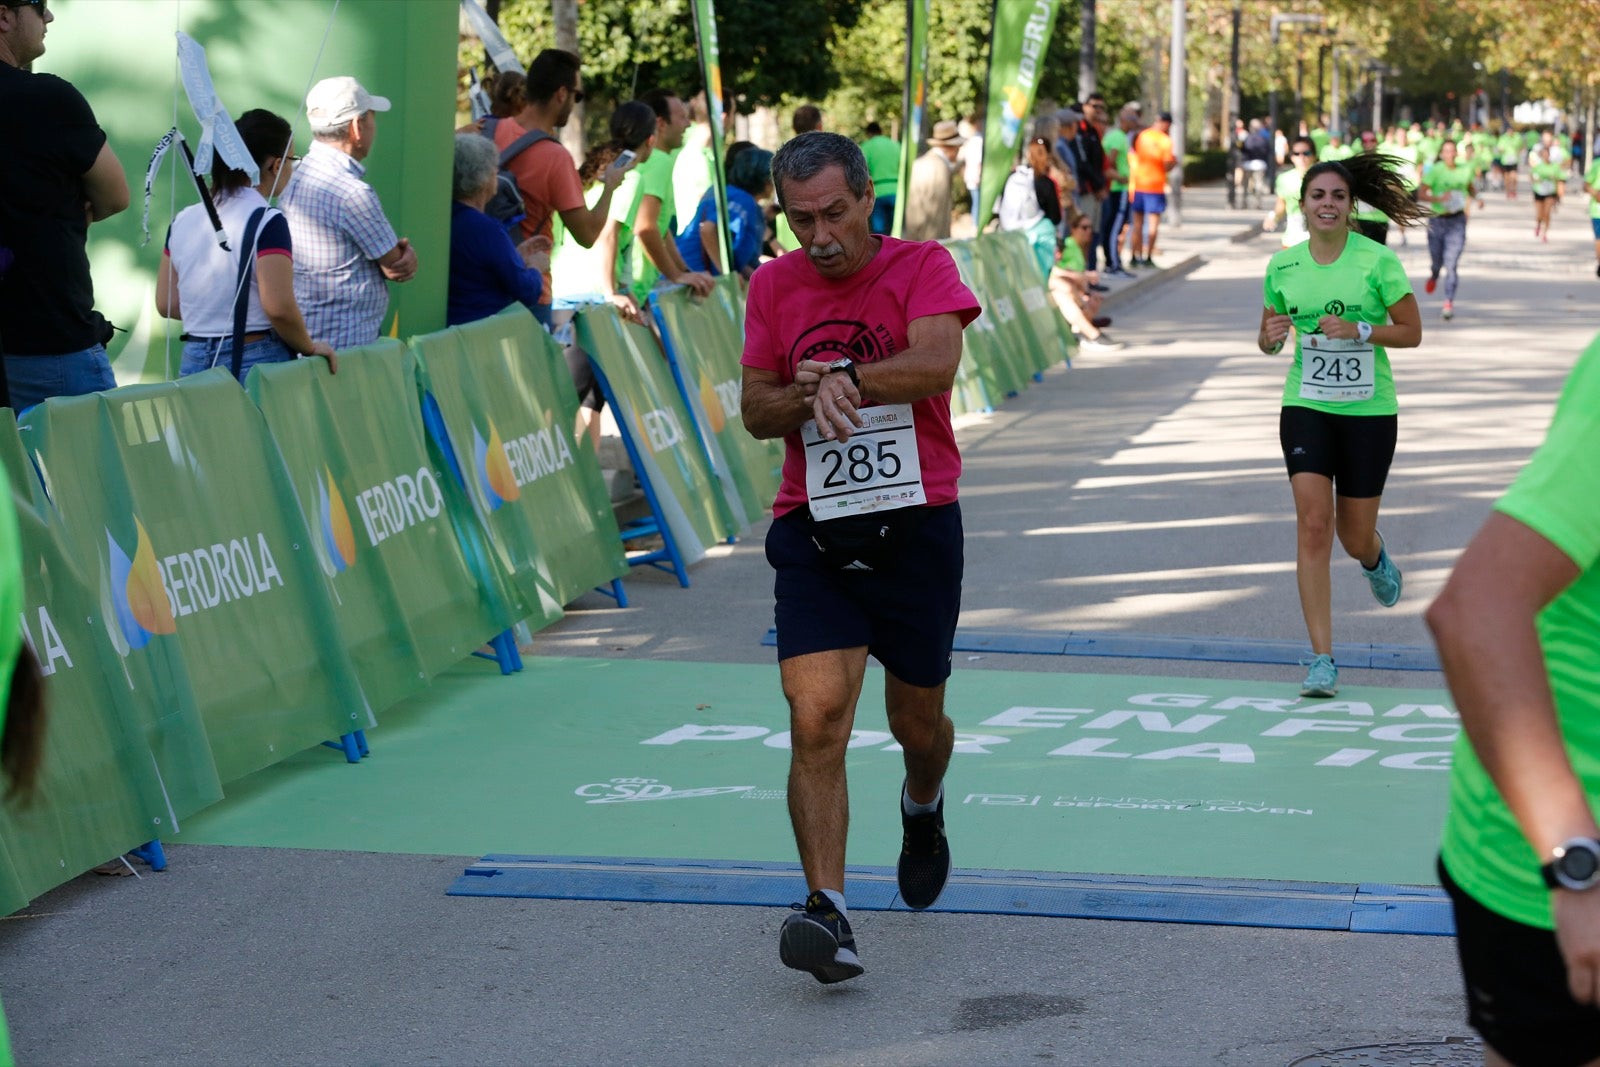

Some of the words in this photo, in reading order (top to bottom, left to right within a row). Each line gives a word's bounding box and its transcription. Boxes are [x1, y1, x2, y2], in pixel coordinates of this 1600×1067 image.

[1312, 356, 1362, 382] 243
[821, 440, 902, 489] 285
[979, 706, 1228, 733] EN
[1046, 737, 1256, 763] LA
[574, 783, 673, 799] CSD
[1053, 801, 1192, 811] DEPORTE
[1203, 806, 1313, 815] JOVEN
